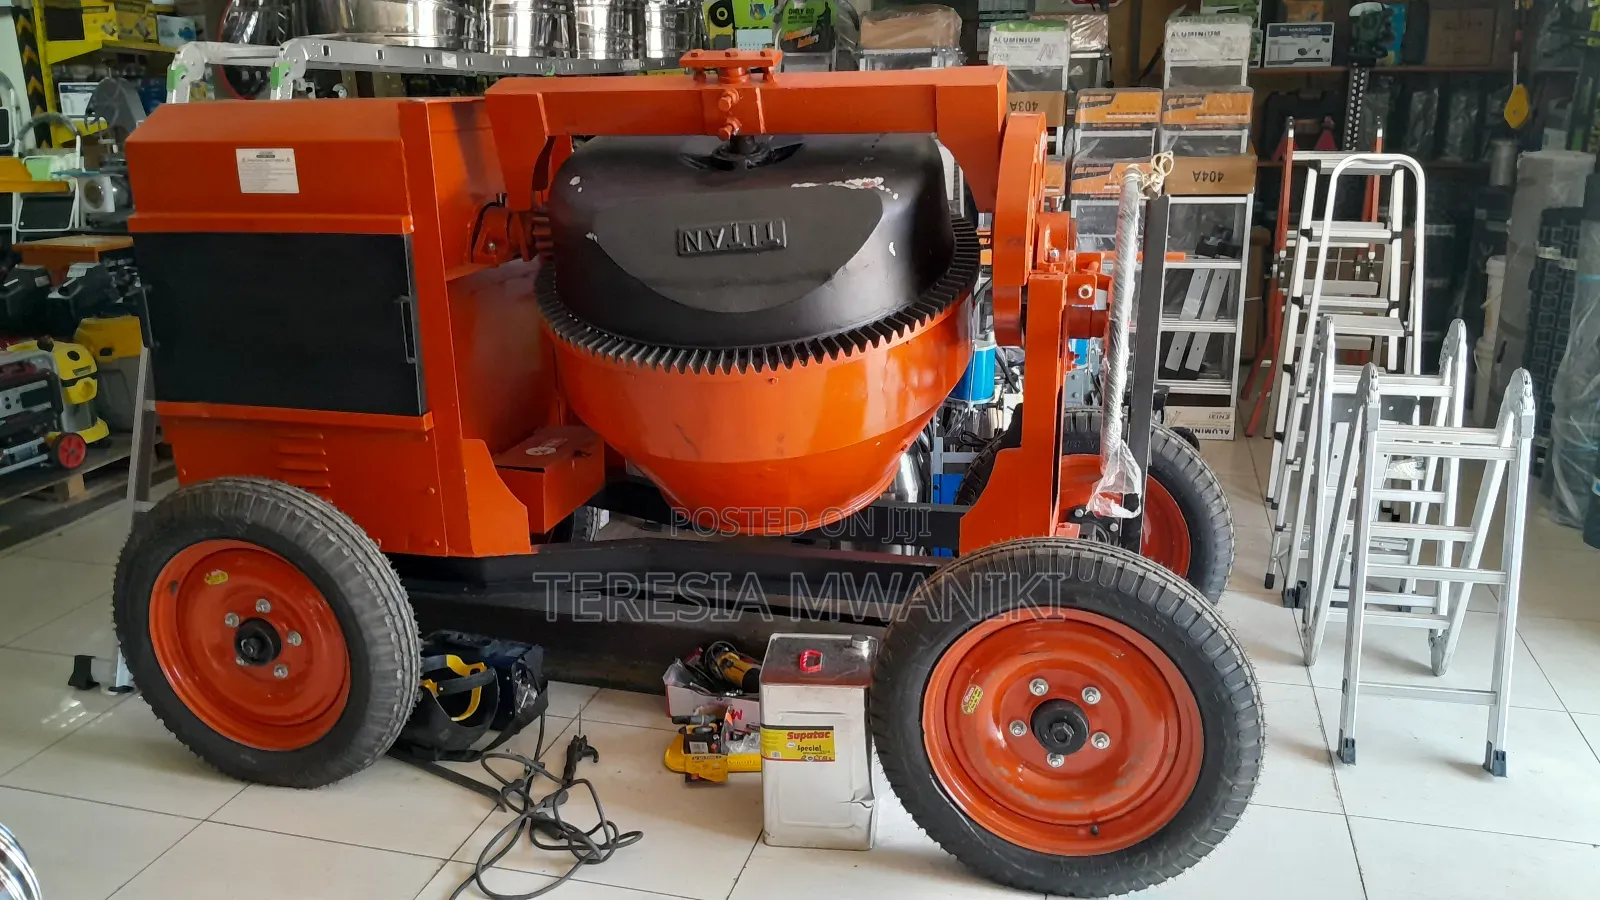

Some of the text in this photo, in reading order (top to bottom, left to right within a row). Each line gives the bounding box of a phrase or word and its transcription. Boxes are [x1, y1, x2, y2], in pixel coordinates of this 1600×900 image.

[1009, 101, 1039, 112] 403A
[1193, 171, 1225, 183] 404A
[682, 220, 784, 252] TITAN
[787, 731, 831, 742] Supatac
[797, 744, 821, 752] Special
